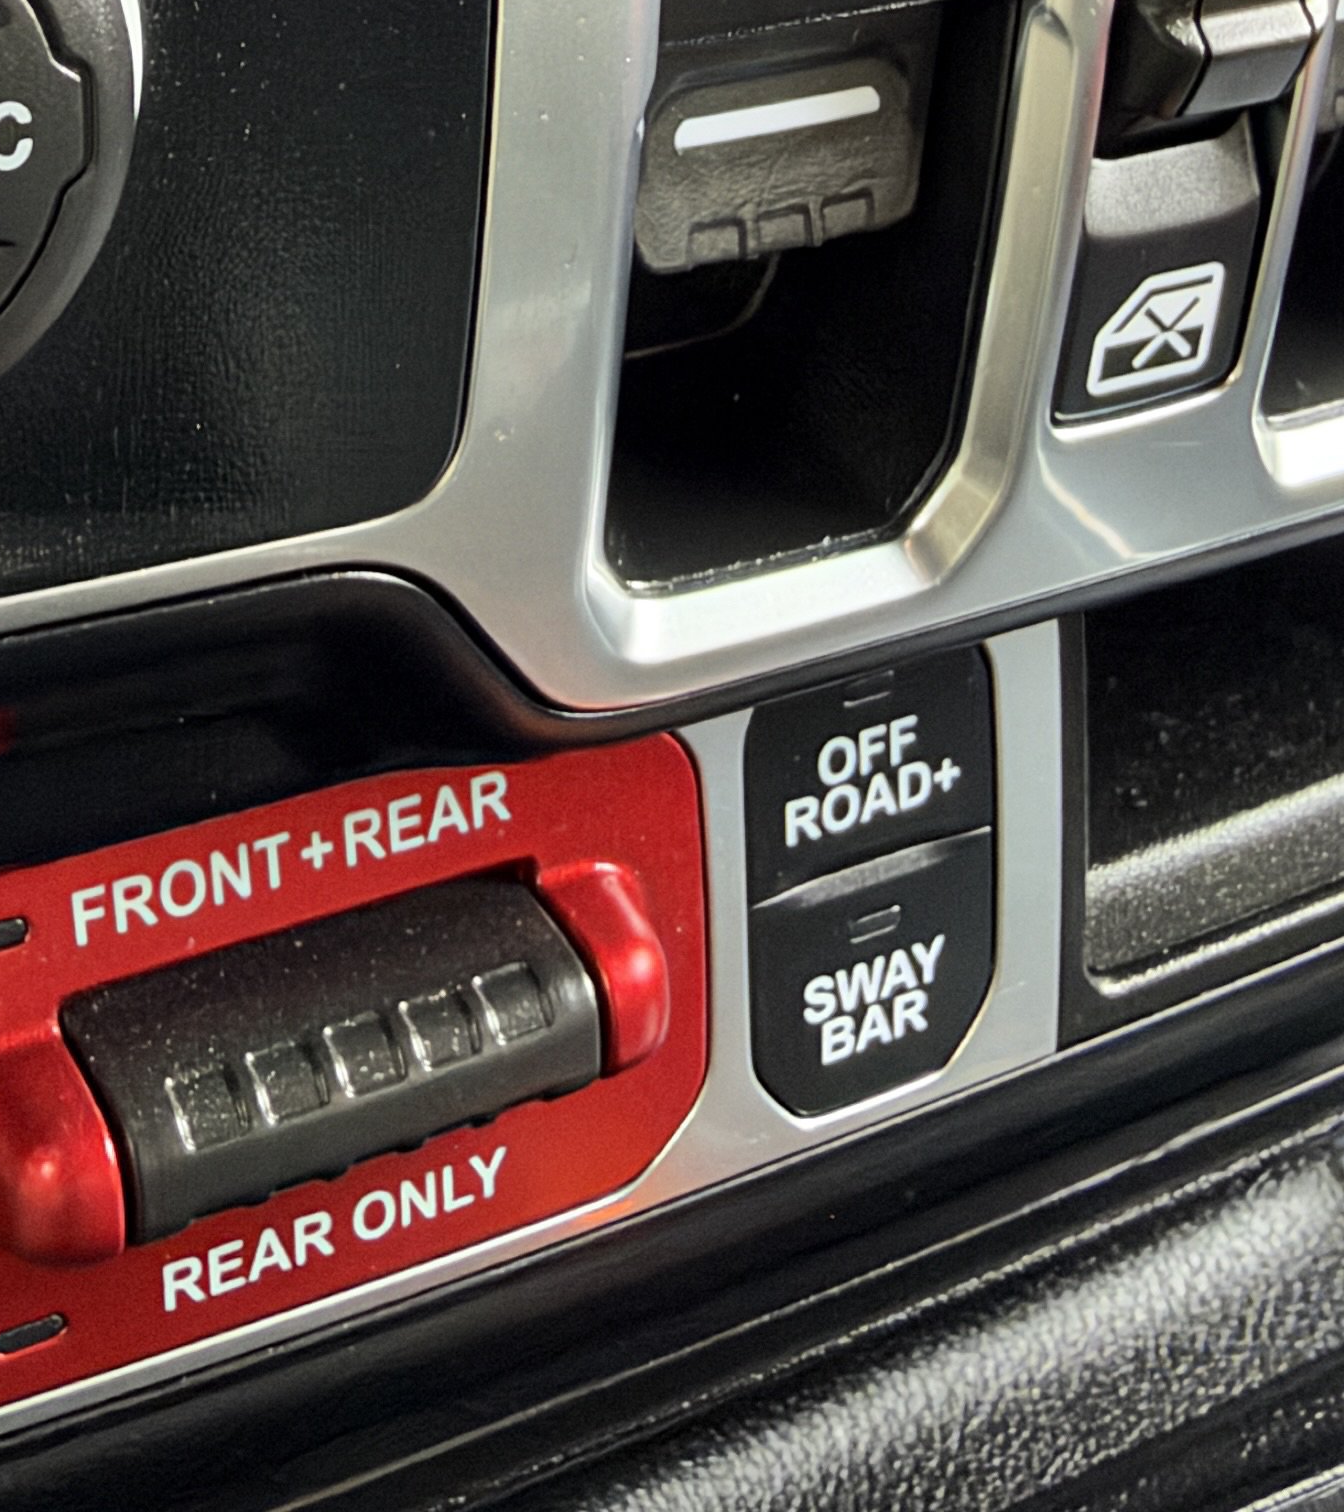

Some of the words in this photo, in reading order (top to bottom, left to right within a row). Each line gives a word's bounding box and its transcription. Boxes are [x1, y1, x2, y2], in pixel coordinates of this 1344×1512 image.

[817, 714, 919, 788] OFF
[783, 756, 962, 848] ROAD+
[71, 770, 510, 946] FRONT+REAR
[801, 933, 946, 1028] SWAY
[819, 992, 928, 1068] BAR
[161, 1210, 336, 1311] REAR
[351, 1147, 507, 1243] ONLY
